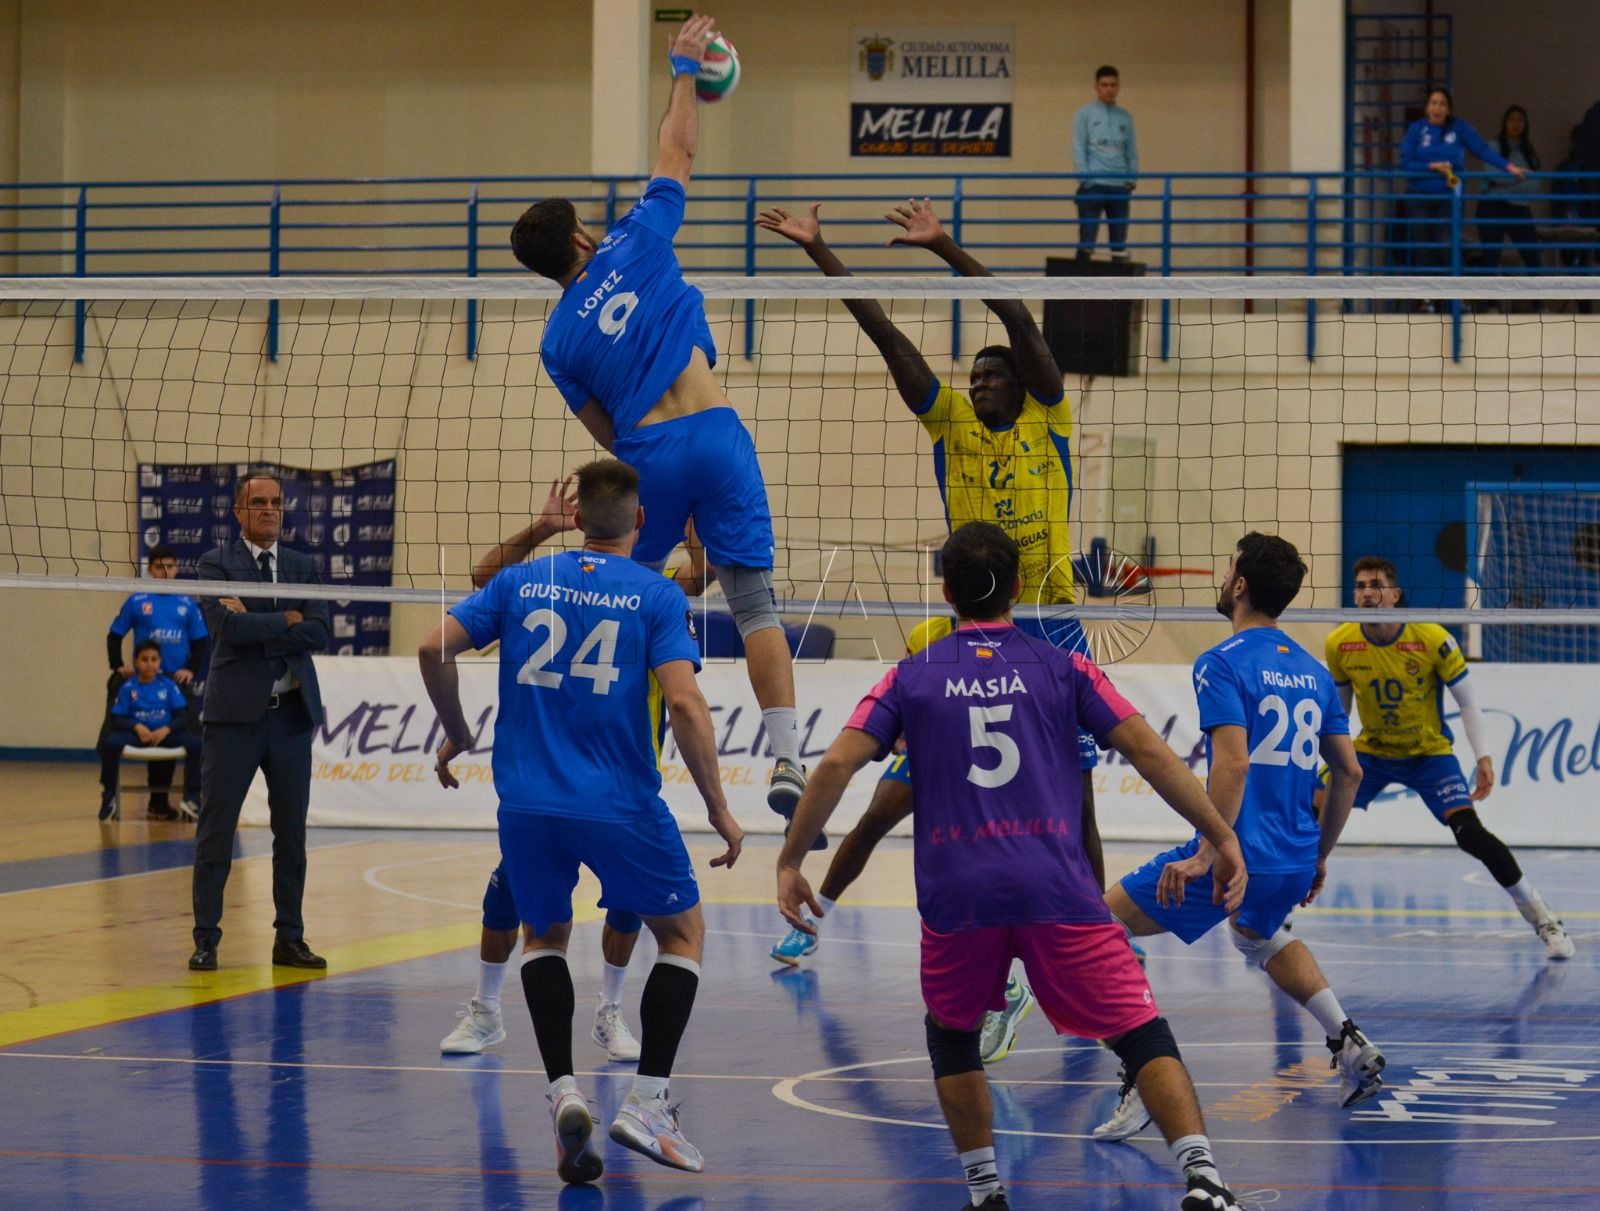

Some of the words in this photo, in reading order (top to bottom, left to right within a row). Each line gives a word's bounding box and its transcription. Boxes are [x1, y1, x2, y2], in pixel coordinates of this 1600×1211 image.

[901, 56, 1011, 78] MELILLA
[858, 107, 1004, 140] MELILLA
[577, 269, 623, 319] LÓPEZ
[597, 291, 640, 345] 9
[519, 581, 641, 611] GIUSTINIANO
[516, 608, 621, 695] 24
[945, 669, 1027, 697] MASIÀ
[1262, 670, 1317, 691] RIGANTI
[1369, 678, 1404, 702] 10
[310, 701, 494, 758] MELIL
[966, 704, 1020, 788] 5
[1249, 694, 1322, 770] 28
[388, 763, 428, 783] DEL
